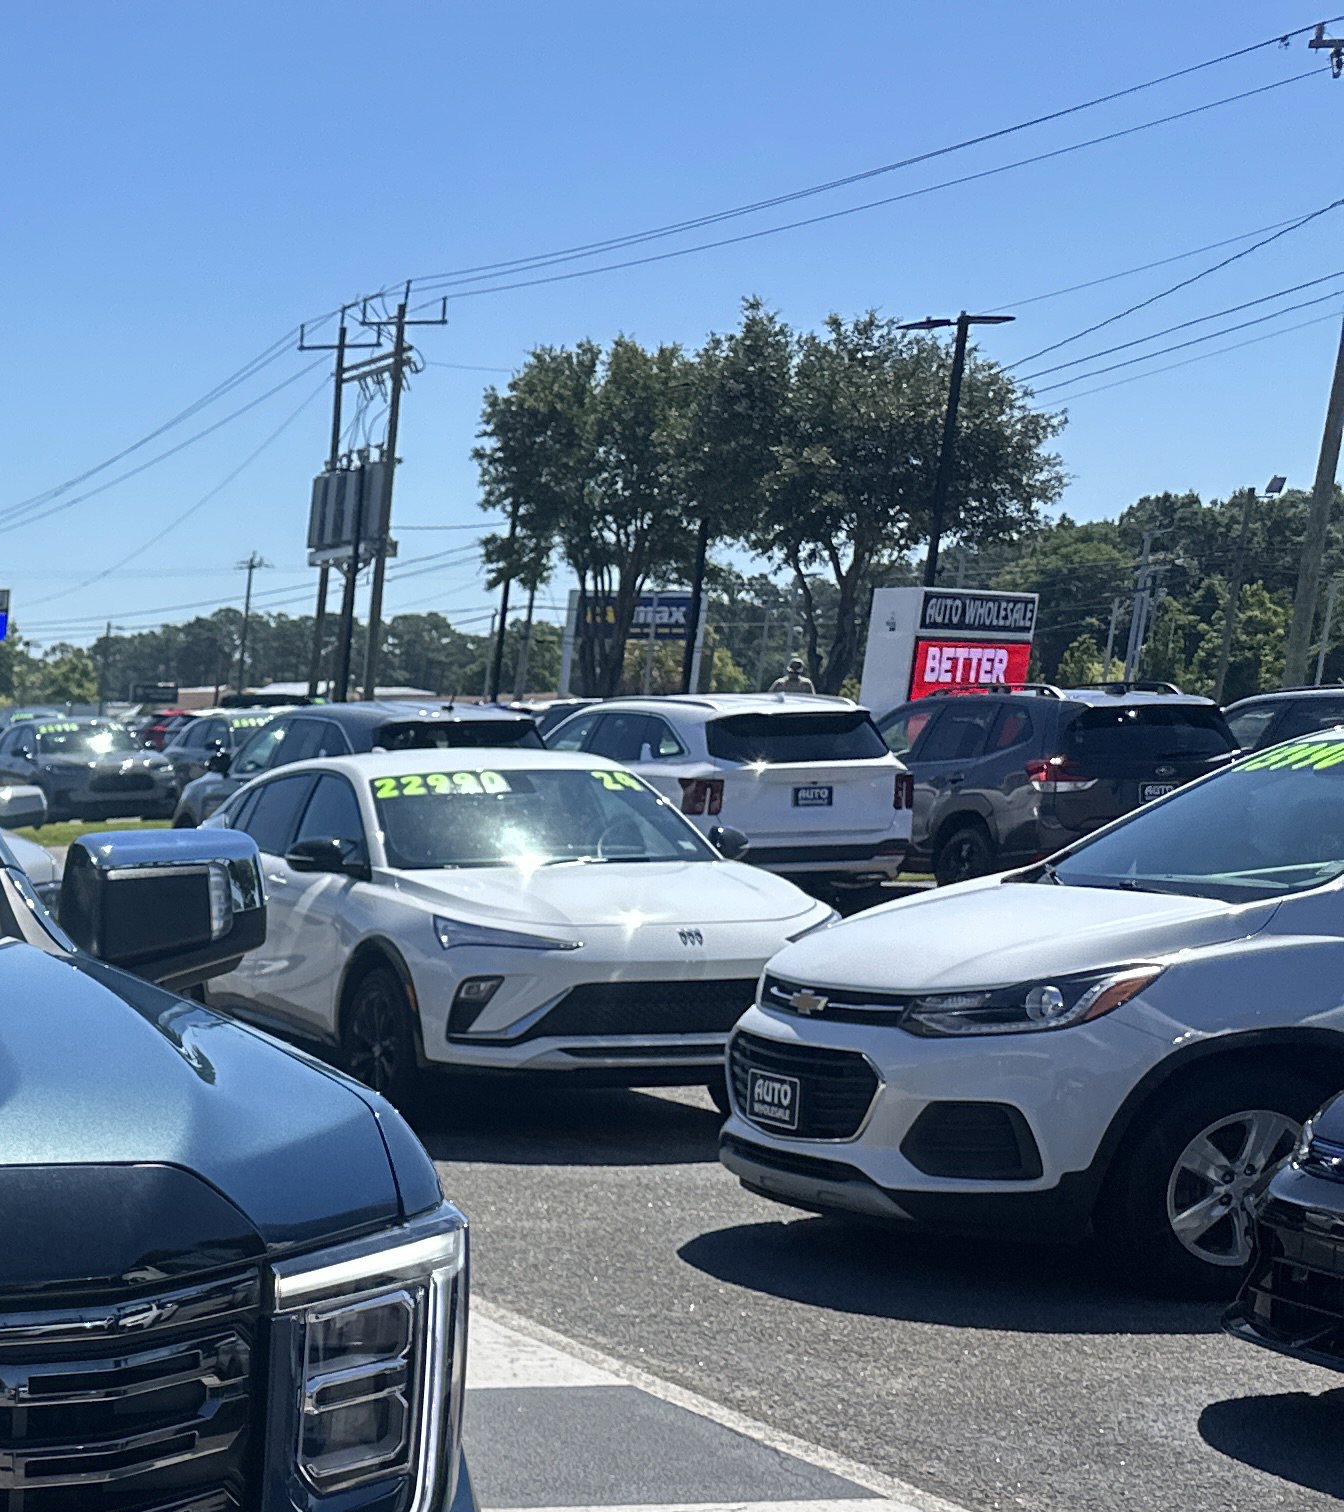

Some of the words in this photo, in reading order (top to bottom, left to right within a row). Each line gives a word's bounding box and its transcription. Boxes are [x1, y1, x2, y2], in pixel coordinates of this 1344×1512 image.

[925, 598, 962, 625] AUTO
[965, 600, 1034, 629] WHOLESALE
[923, 646, 1009, 684] BETTER
[374, 771, 512, 799] 22990
[590, 771, 645, 791] 24
[797, 788, 829, 800] AUTO
[754, 1078, 792, 1107] AUTO
